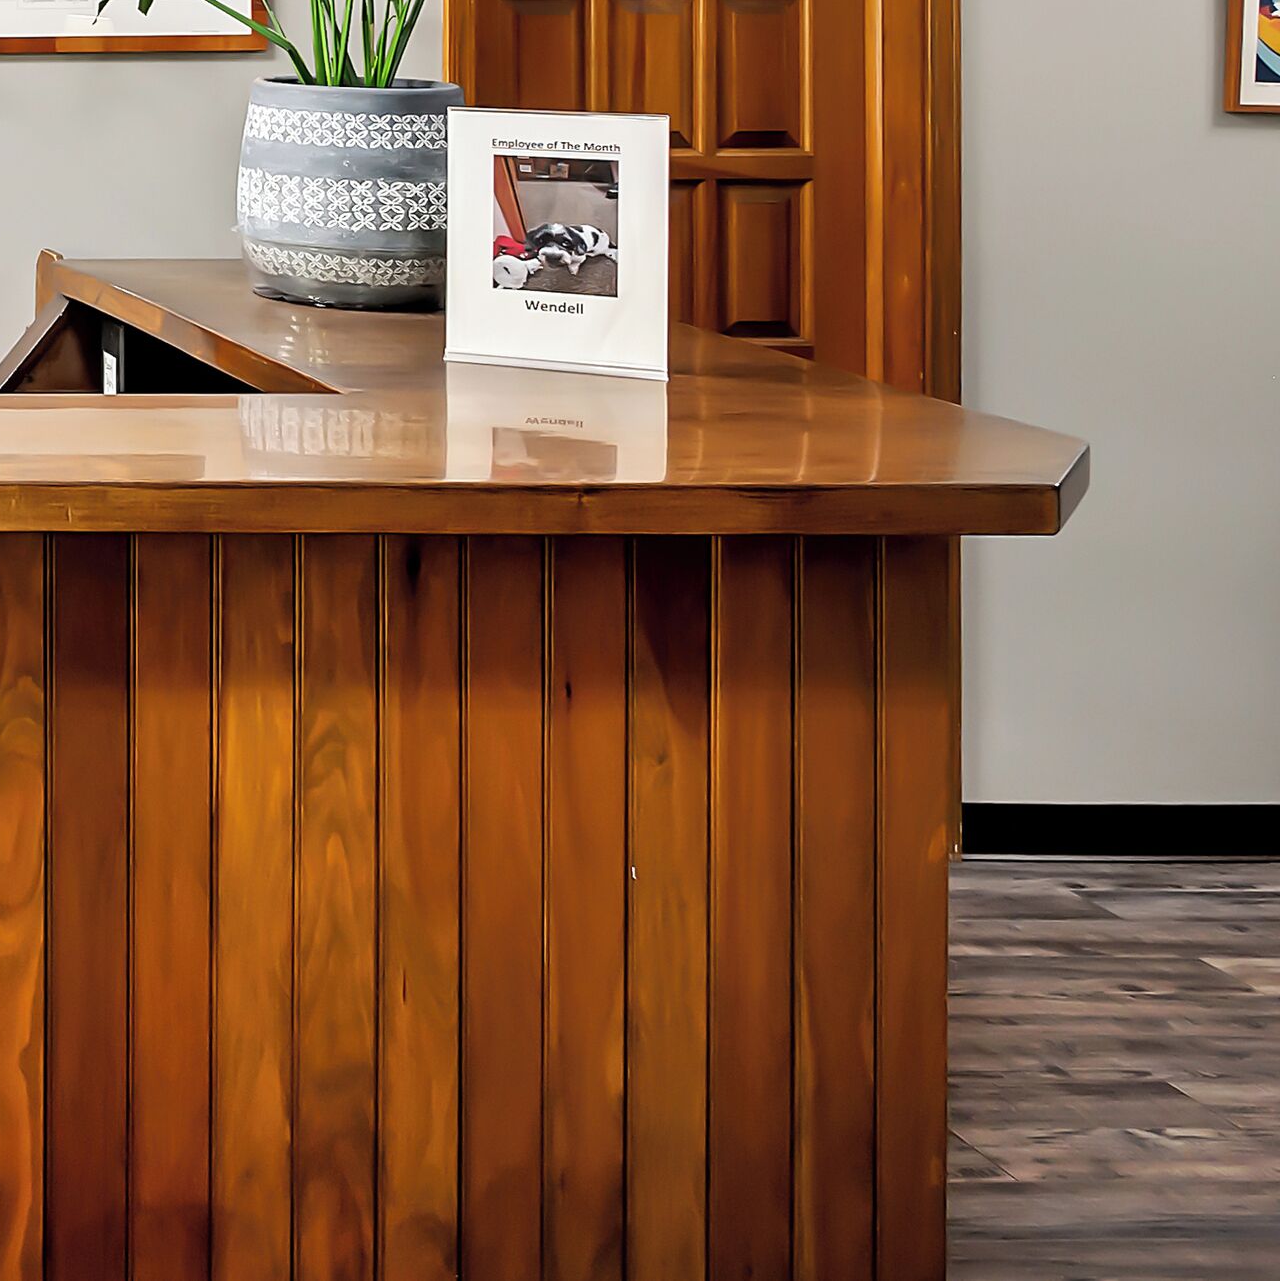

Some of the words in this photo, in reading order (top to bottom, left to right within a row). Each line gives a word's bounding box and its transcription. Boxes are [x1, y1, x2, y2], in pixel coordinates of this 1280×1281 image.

[492, 139, 543, 149] Employee
[547, 141, 558, 149] of
[560, 141, 580, 150] The
[584, 143, 620, 151] Month
[525, 300, 584, 314] Wendell
